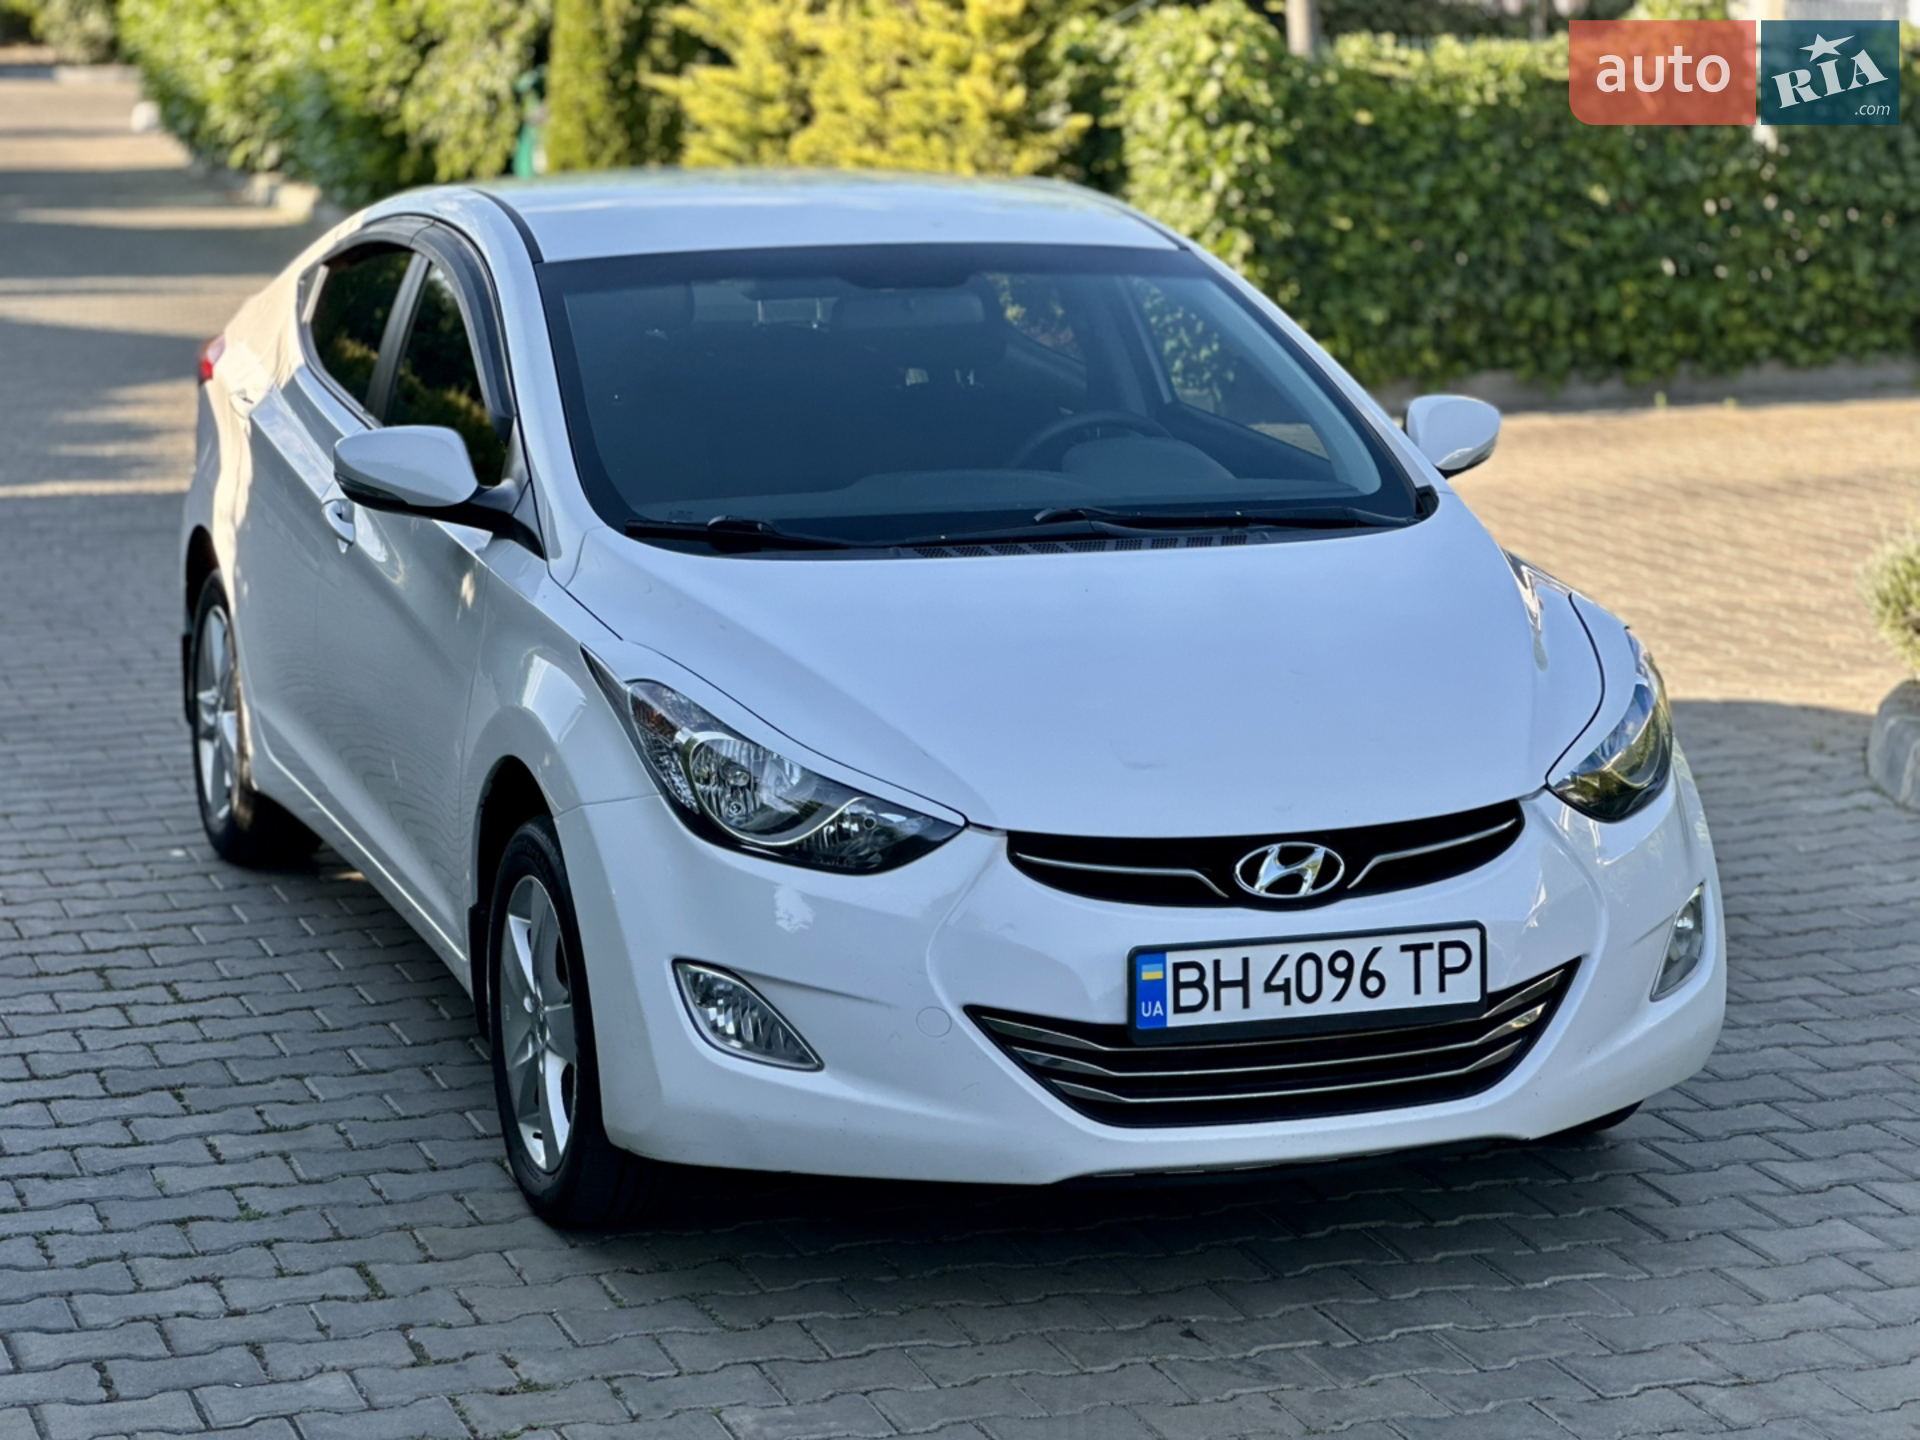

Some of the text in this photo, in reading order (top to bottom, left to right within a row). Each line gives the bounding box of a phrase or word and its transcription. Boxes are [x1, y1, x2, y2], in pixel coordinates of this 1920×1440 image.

[1172, 940, 1472, 1015] BH 4096 TP
[1141, 1001, 1164, 1018] UA
